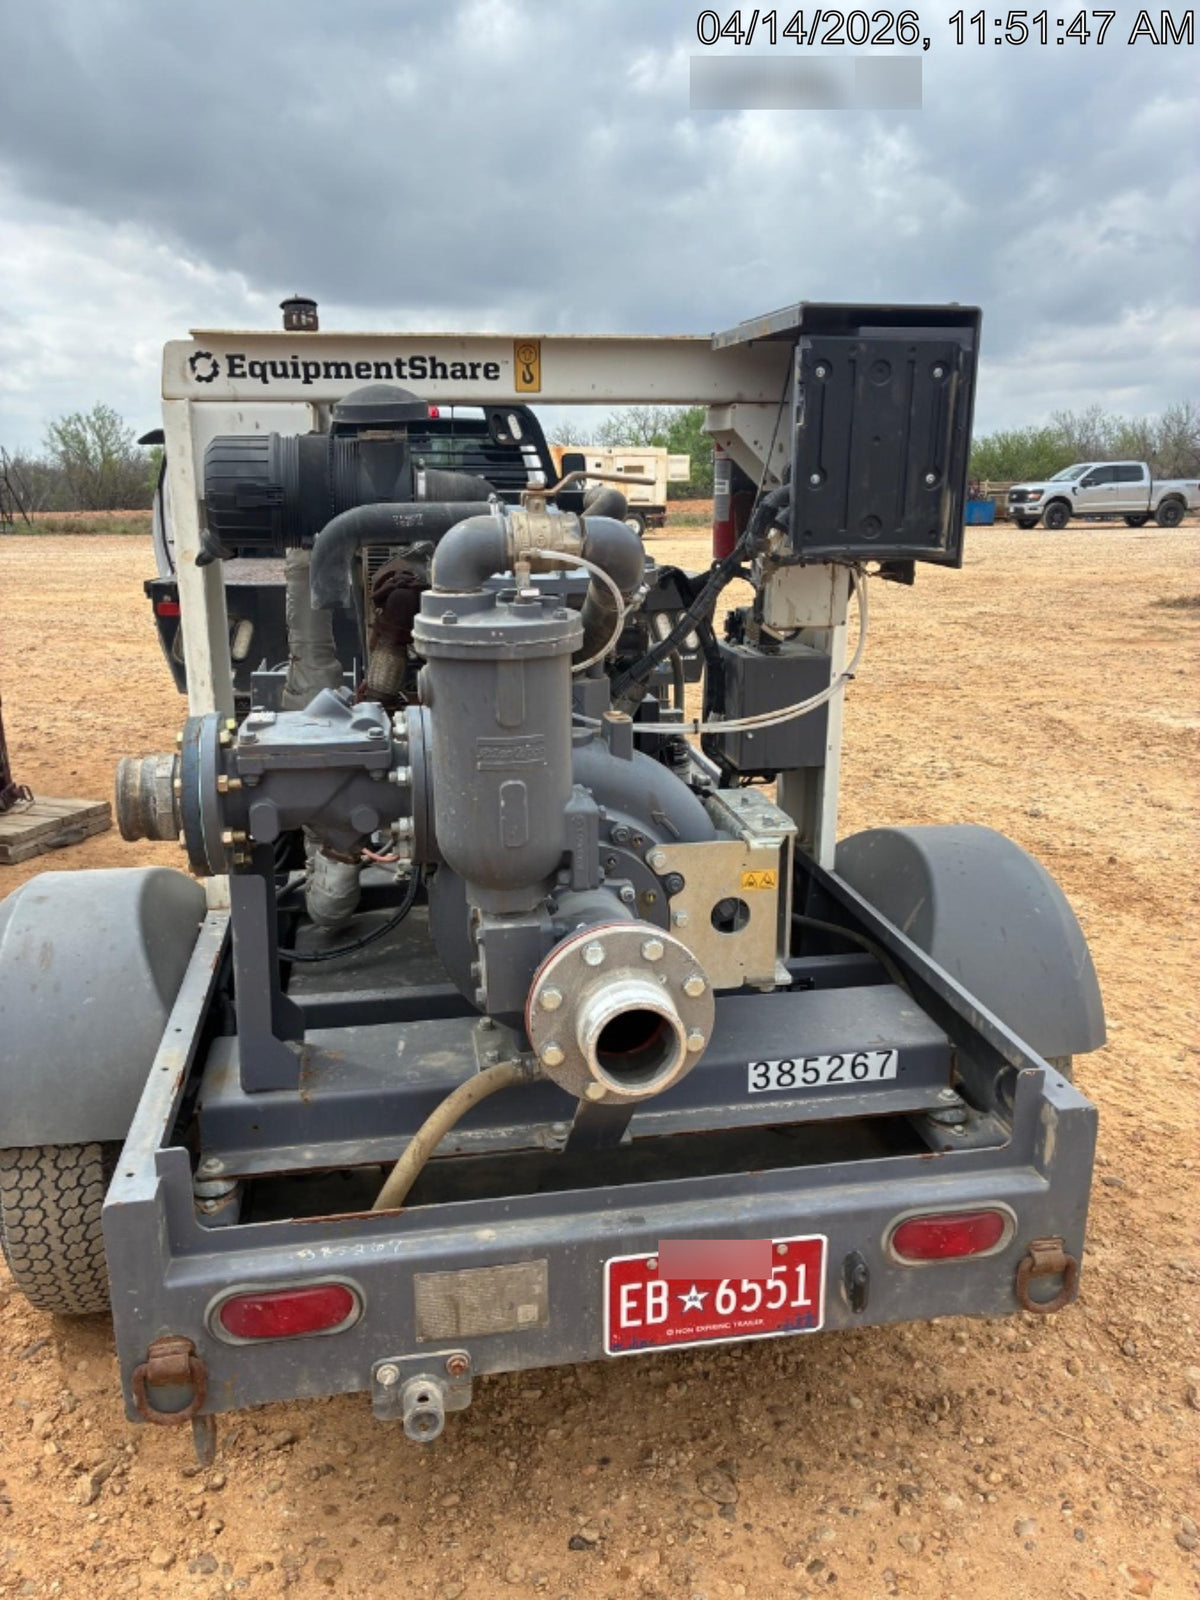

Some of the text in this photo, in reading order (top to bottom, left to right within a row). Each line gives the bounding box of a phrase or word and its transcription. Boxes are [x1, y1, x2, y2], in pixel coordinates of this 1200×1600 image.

[225, 354, 501, 385] EquipmentShare
[752, 1050, 893, 1090] 385267
[619, 1263, 812, 1329] EB 6551
[675, 1327, 694, 1336] NON
[733, 1318, 764, 1328] TRAILER
